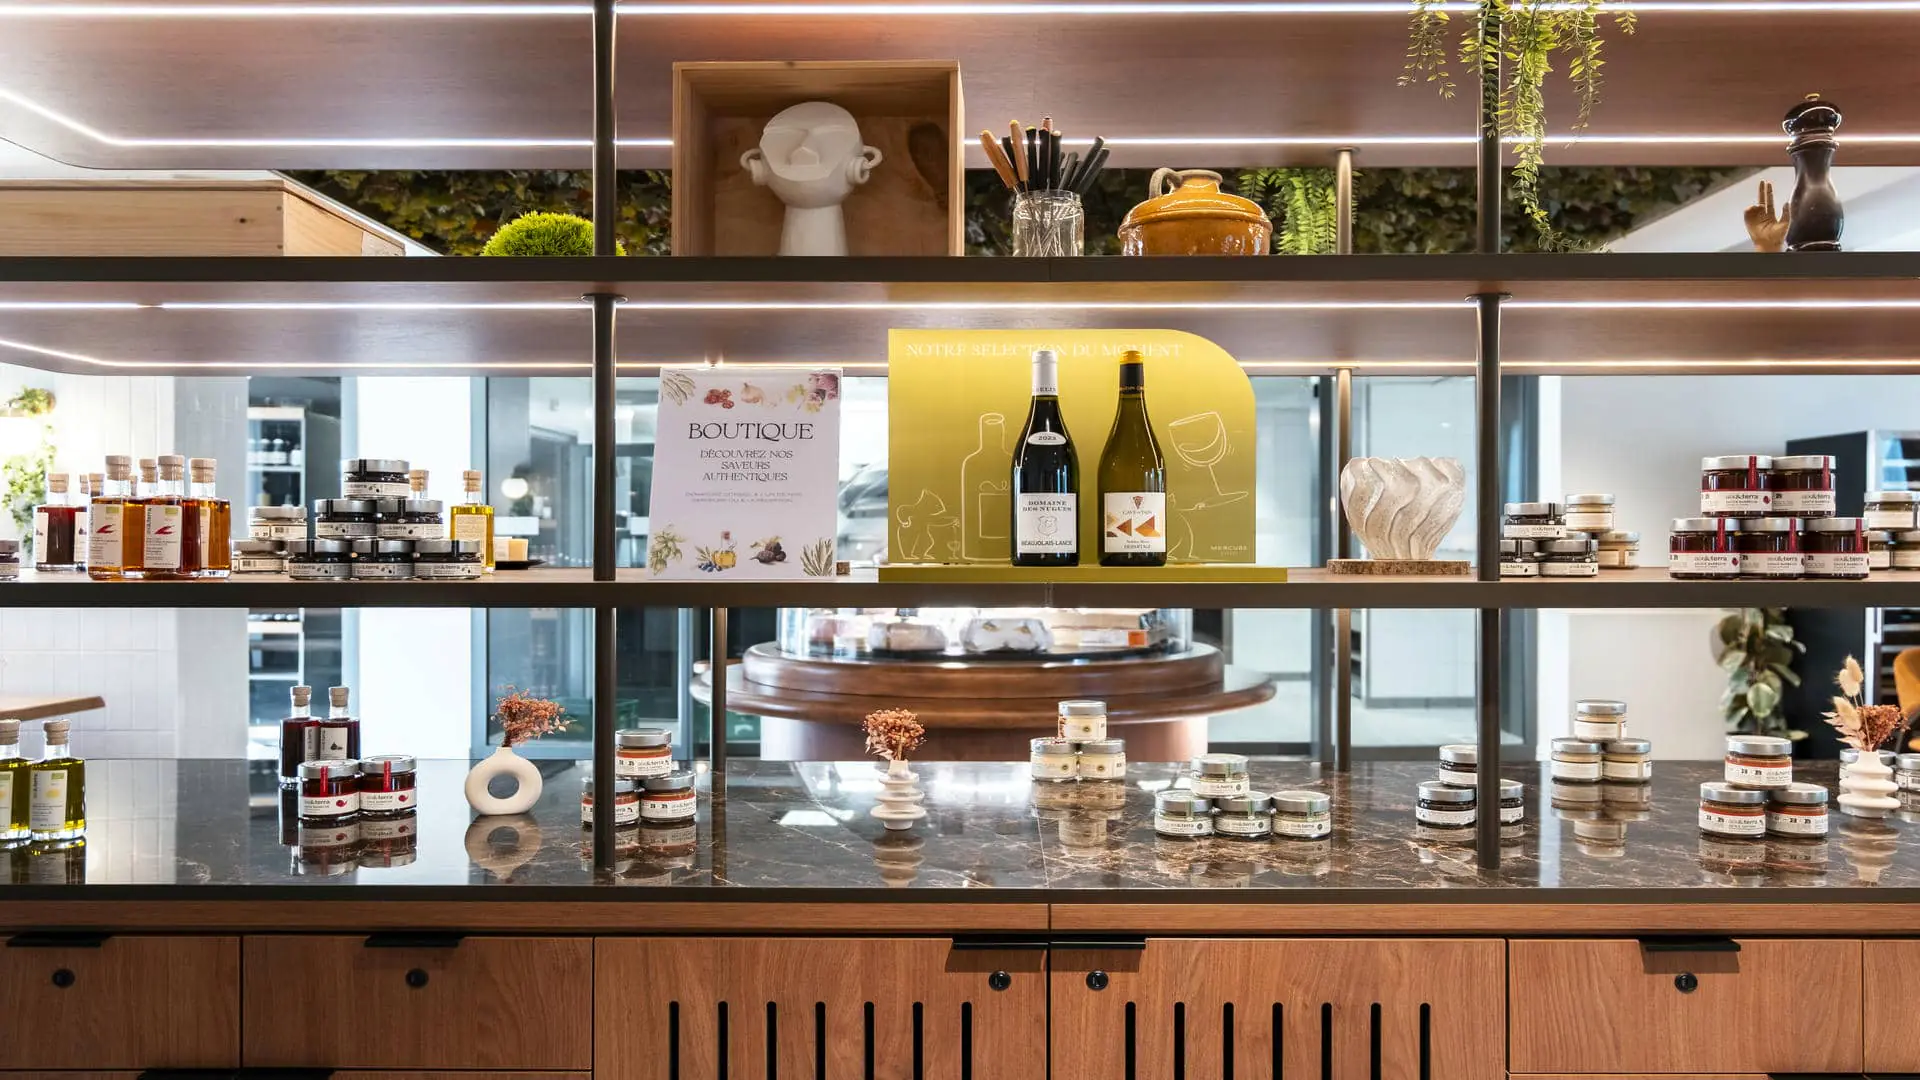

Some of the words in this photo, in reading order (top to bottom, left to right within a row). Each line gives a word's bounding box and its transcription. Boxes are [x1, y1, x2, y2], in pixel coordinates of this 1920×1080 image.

[905, 343, 966, 356] NOTRE
[1073, 343, 1098, 356] DU
[688, 422, 814, 442] BOUTIQUE
[700, 448, 766, 458] DÉCOUVREZ
[769, 450, 793, 458] NOS
[721, 461, 771, 470] SAVEURS
[702, 472, 788, 482] AUTHENTIQUES
